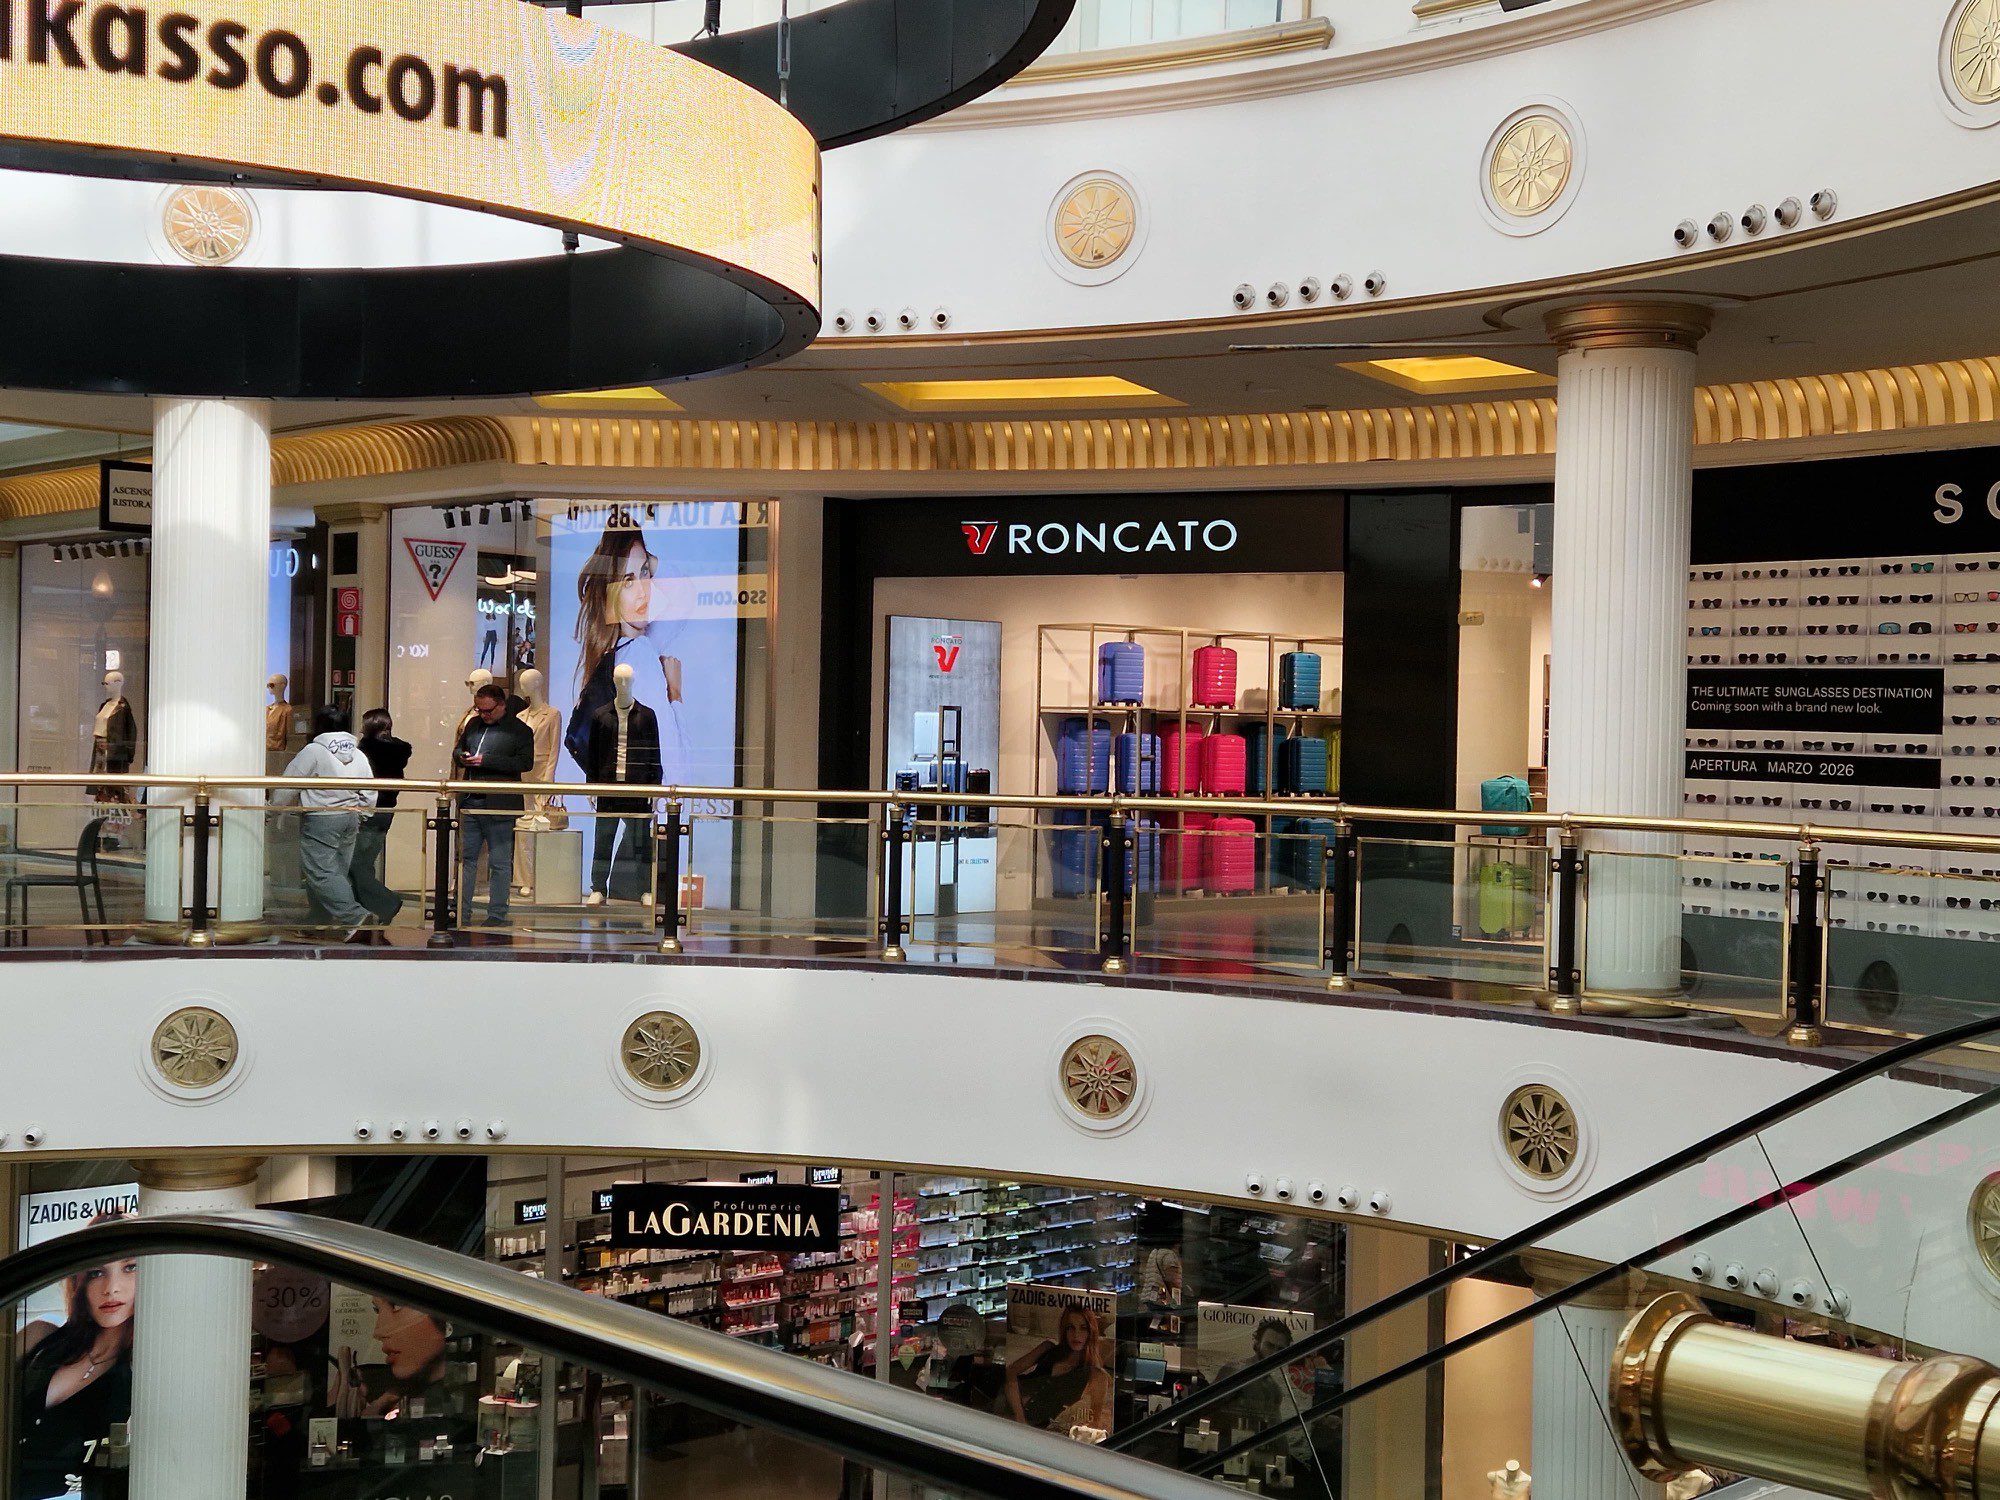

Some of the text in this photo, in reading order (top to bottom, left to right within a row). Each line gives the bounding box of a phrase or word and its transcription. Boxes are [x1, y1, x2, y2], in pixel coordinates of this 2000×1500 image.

[1008, 518, 1238, 554] RONCATO
[415, 544, 456, 559] GUESS
[1692, 686, 1933, 700] THE ULTIMATE SUNGLASSES DESTINATION
[1691, 700, 1883, 714] Coming soon with a brand new look.
[1690, 758, 1855, 777] APERTURA MARZO 2026
[713, 1201, 801, 1211] Profumerie
[1203, 1309, 1256, 1325] GIORGIO
